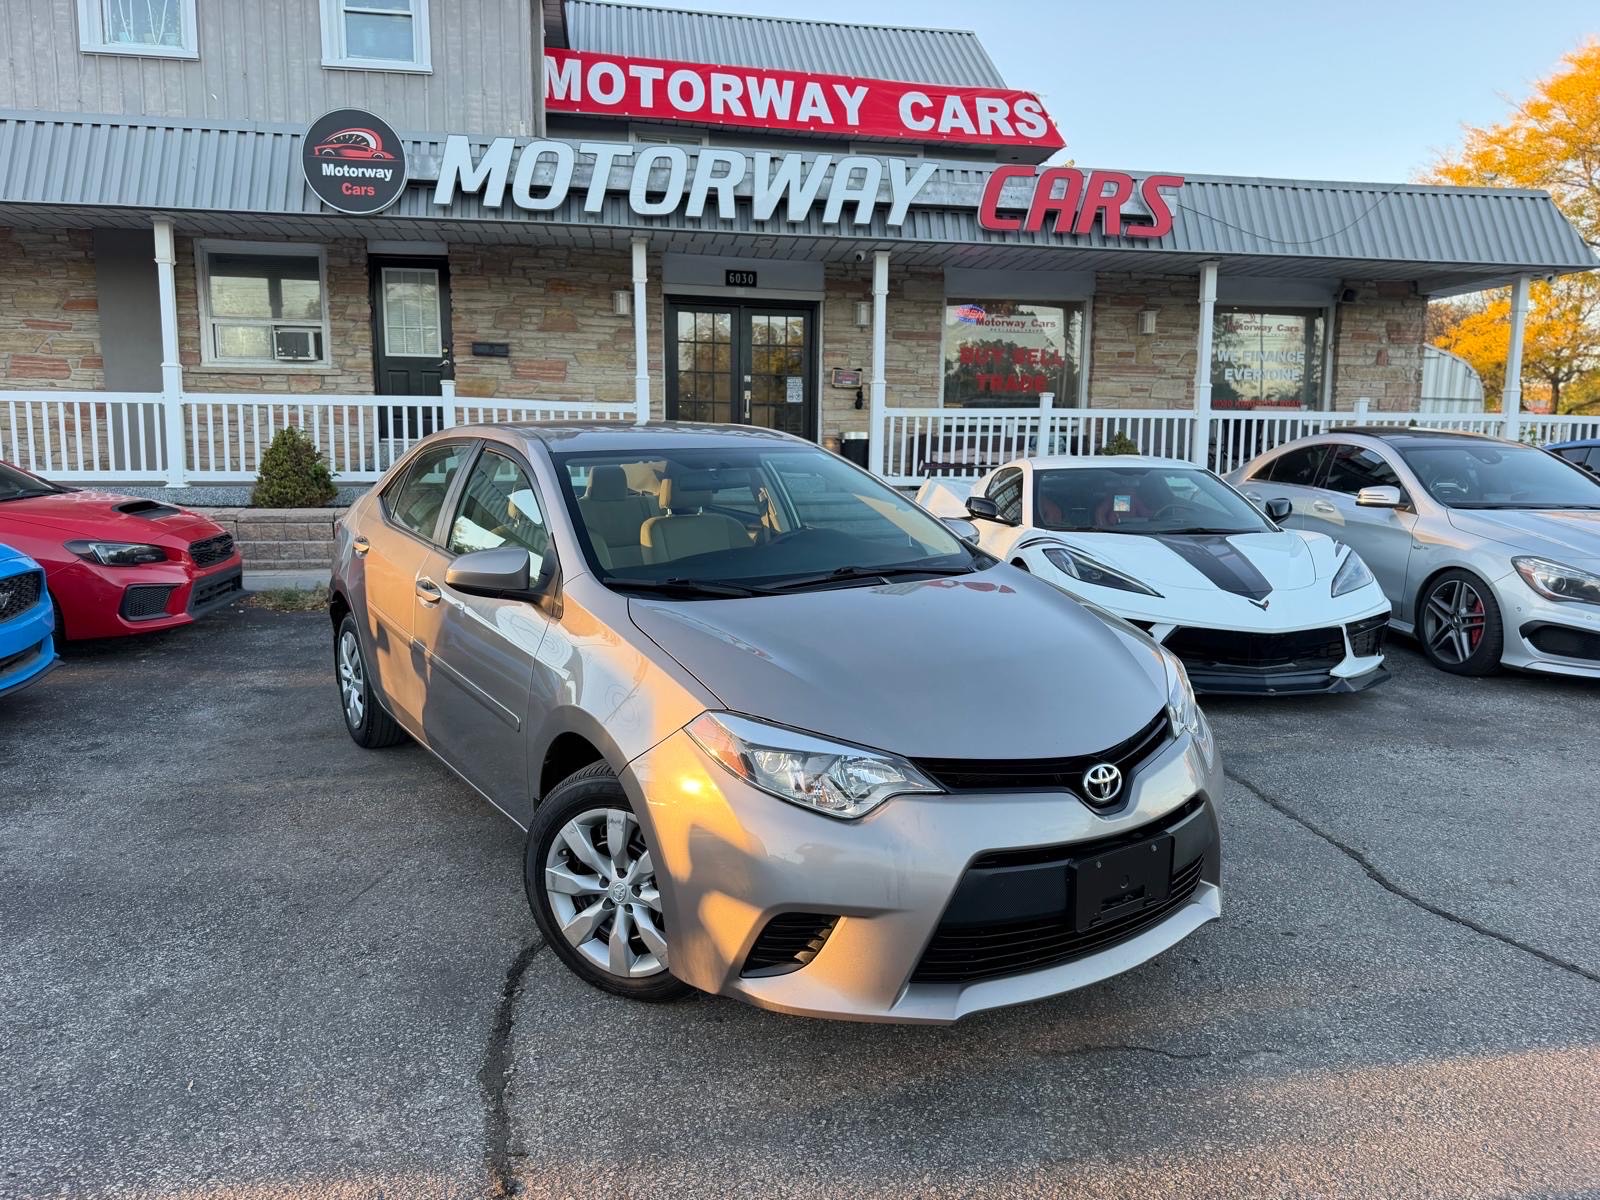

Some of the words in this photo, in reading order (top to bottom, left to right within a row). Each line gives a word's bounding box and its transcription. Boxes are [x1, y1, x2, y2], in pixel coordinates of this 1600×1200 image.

[544, 55, 869, 126] MOTORWAY
[899, 91, 1047, 138] CARS
[321, 163, 393, 181] Motorway
[341, 182, 376, 196] Cars
[433, 134, 939, 226] MOTORWAY
[977, 164, 1184, 238] CARS
[729, 272, 754, 285] 6030
[955, 307, 986, 321] OPEN
[975, 317, 1026, 329] Motorway
[1031, 318, 1056, 328] Cars
[1226, 322, 1273, 334] Motorway
[1276, 323, 1300, 333] Cars
[959, 347, 1006, 366] BUY
[1217, 350, 1241, 362] WE
[1243, 350, 1305, 362] FINANCE
[975, 374, 1048, 392] TRADE
